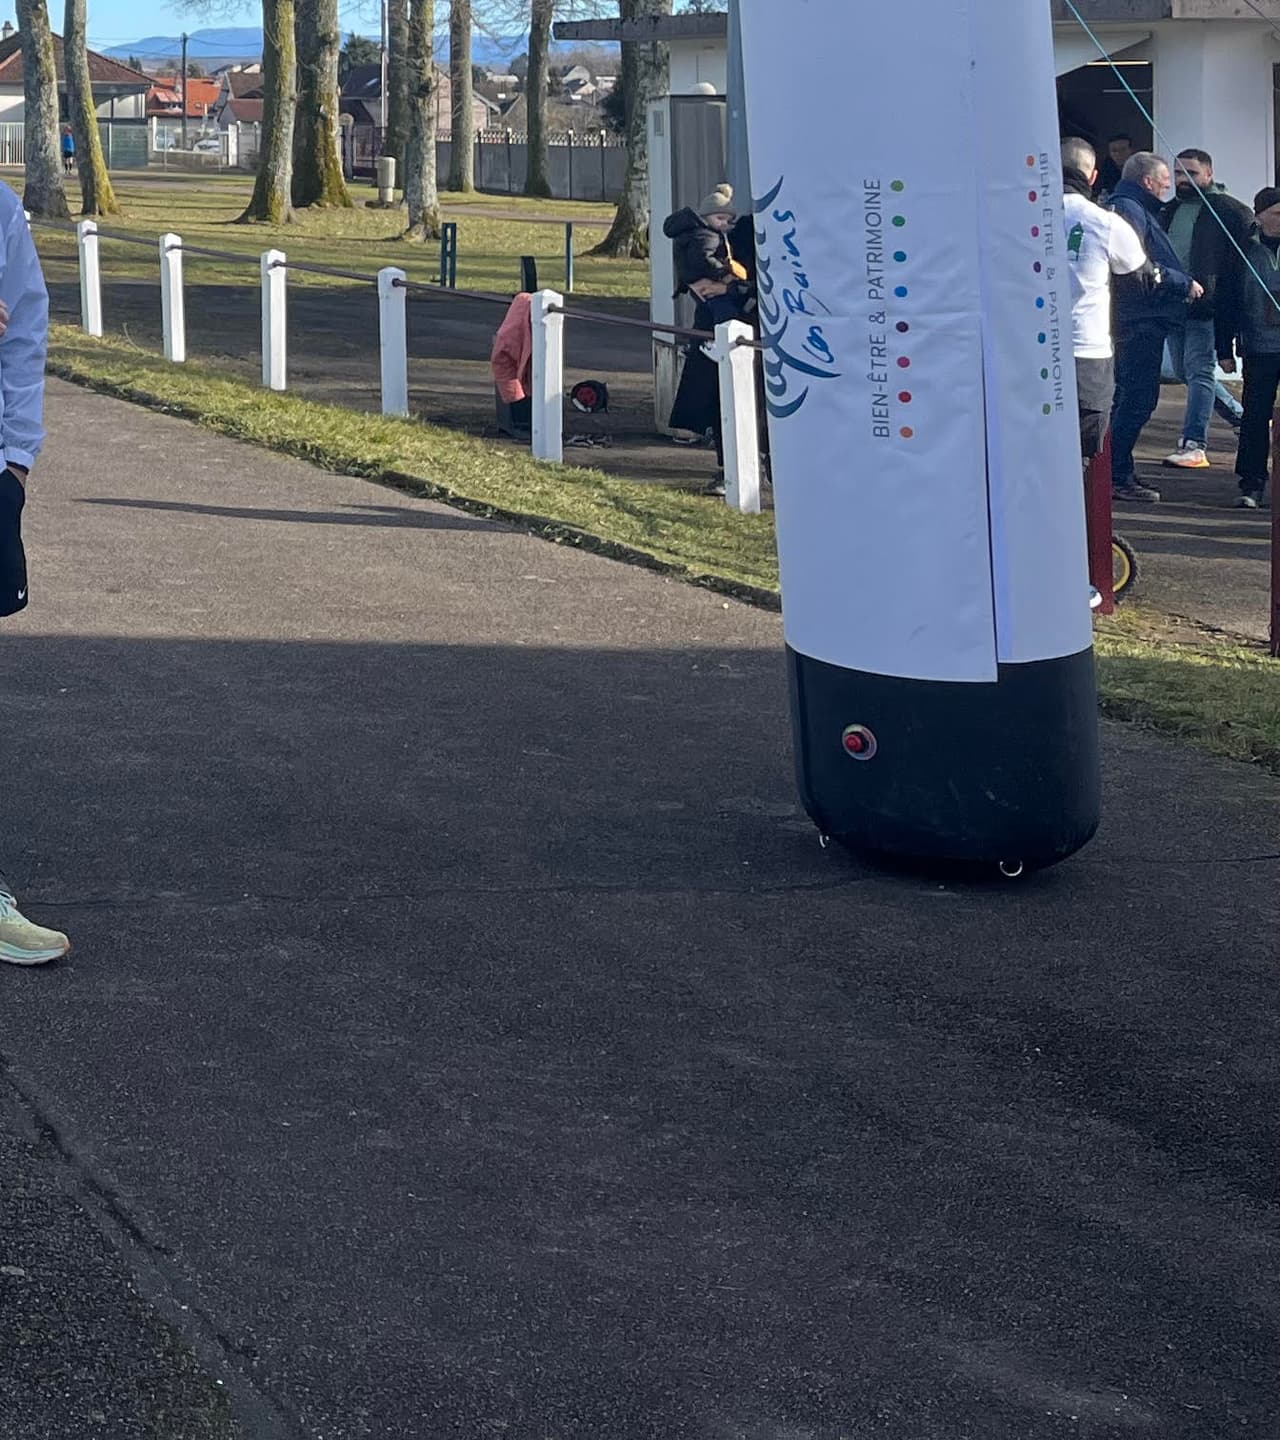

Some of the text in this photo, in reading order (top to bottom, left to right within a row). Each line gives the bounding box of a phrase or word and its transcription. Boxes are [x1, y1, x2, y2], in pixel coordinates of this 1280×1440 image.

[772, 209, 832, 316] Bains
[863, 178, 891, 438] BIEN-ÊTRE & PATRIMOINE
[1048, 291, 1065, 413] PATRIMOINE
